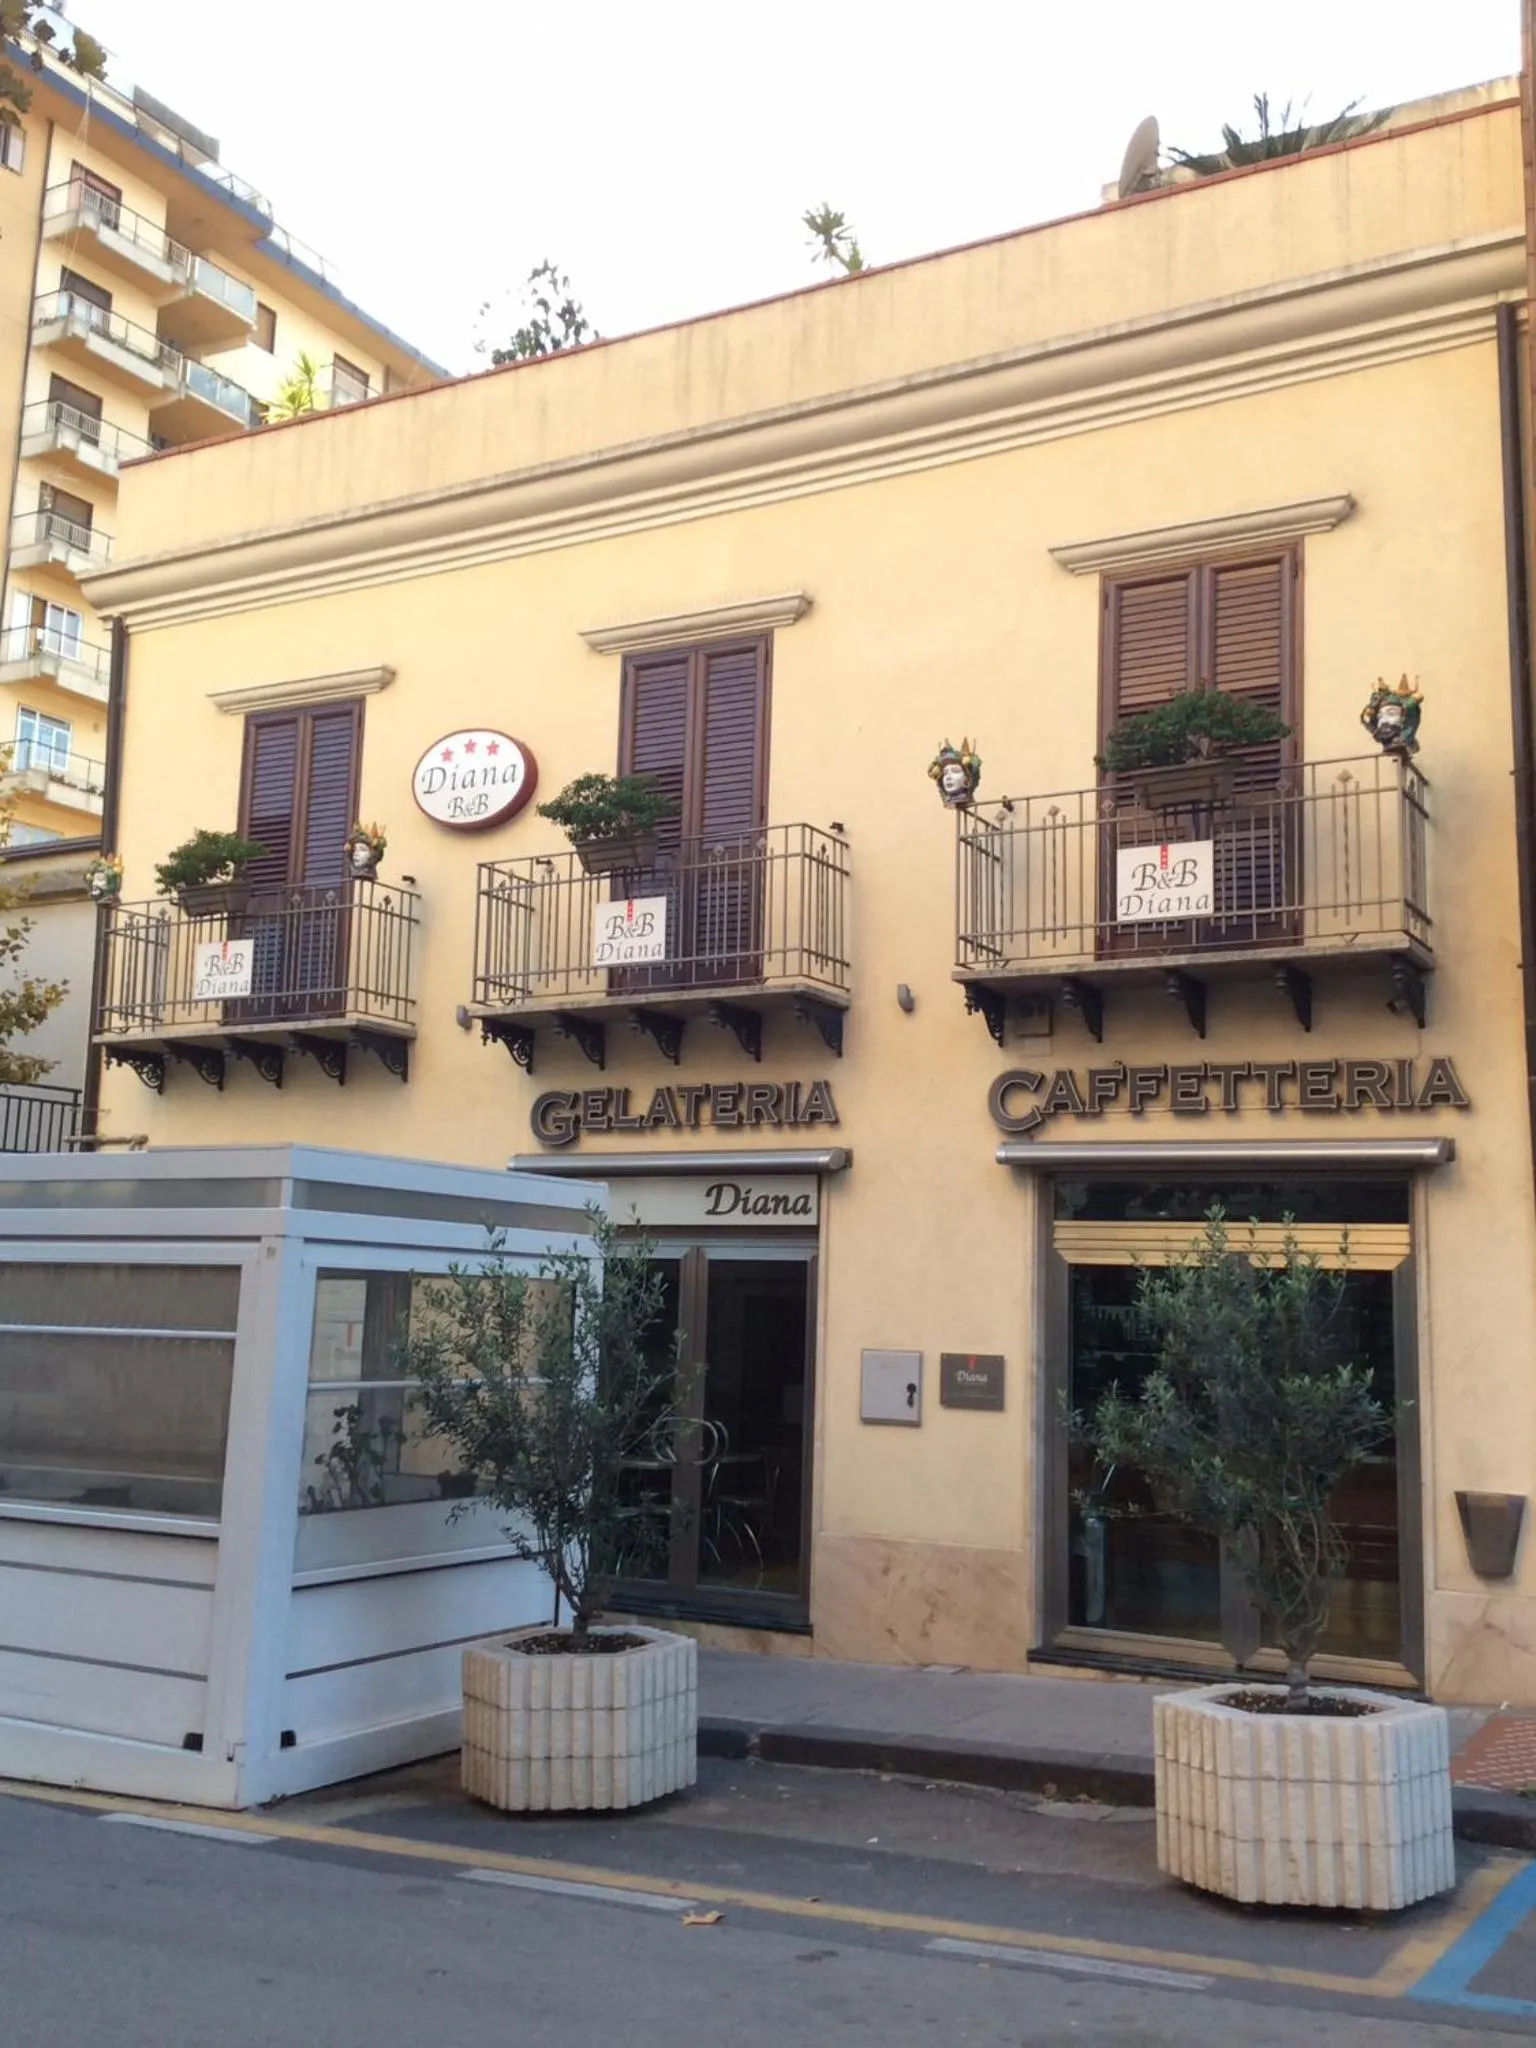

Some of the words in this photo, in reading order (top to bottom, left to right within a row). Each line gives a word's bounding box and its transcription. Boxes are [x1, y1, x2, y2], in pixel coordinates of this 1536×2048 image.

[421, 763, 517, 795] Diana
[447, 793, 489, 819] B&B
[1131, 858, 1198, 892] B&B
[1119, 892, 1210, 917] Diana
[604, 911, 655, 940] B&B
[595, 941, 662, 962] Diana
[196, 978, 249, 996] Diana
[987, 1058, 1470, 1132] CAFFETTERIA
[530, 1079, 840, 1146] GELATERIA
[704, 1181, 812, 1217] Diana
